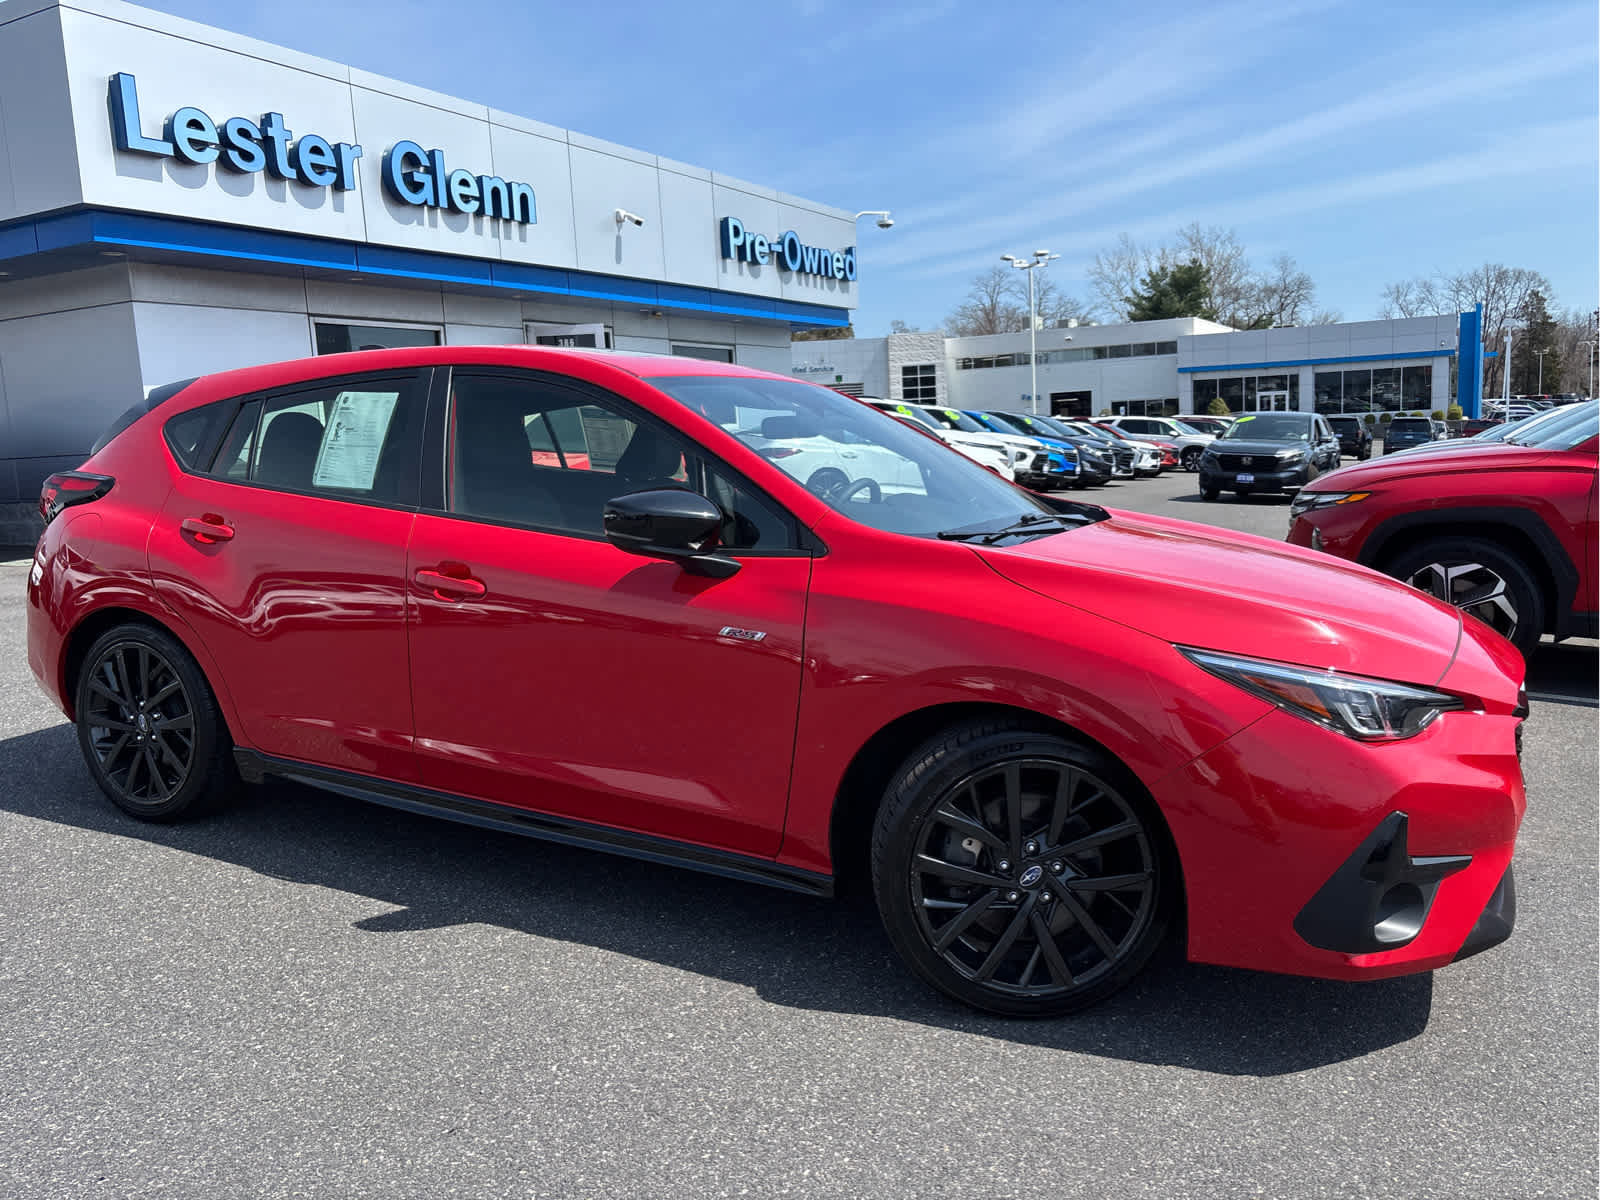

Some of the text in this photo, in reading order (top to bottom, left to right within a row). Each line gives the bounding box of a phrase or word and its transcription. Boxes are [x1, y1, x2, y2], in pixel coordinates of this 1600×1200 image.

[109, 72, 537, 224] Lester Glenn
[720, 216, 857, 281] Pre-Owned
